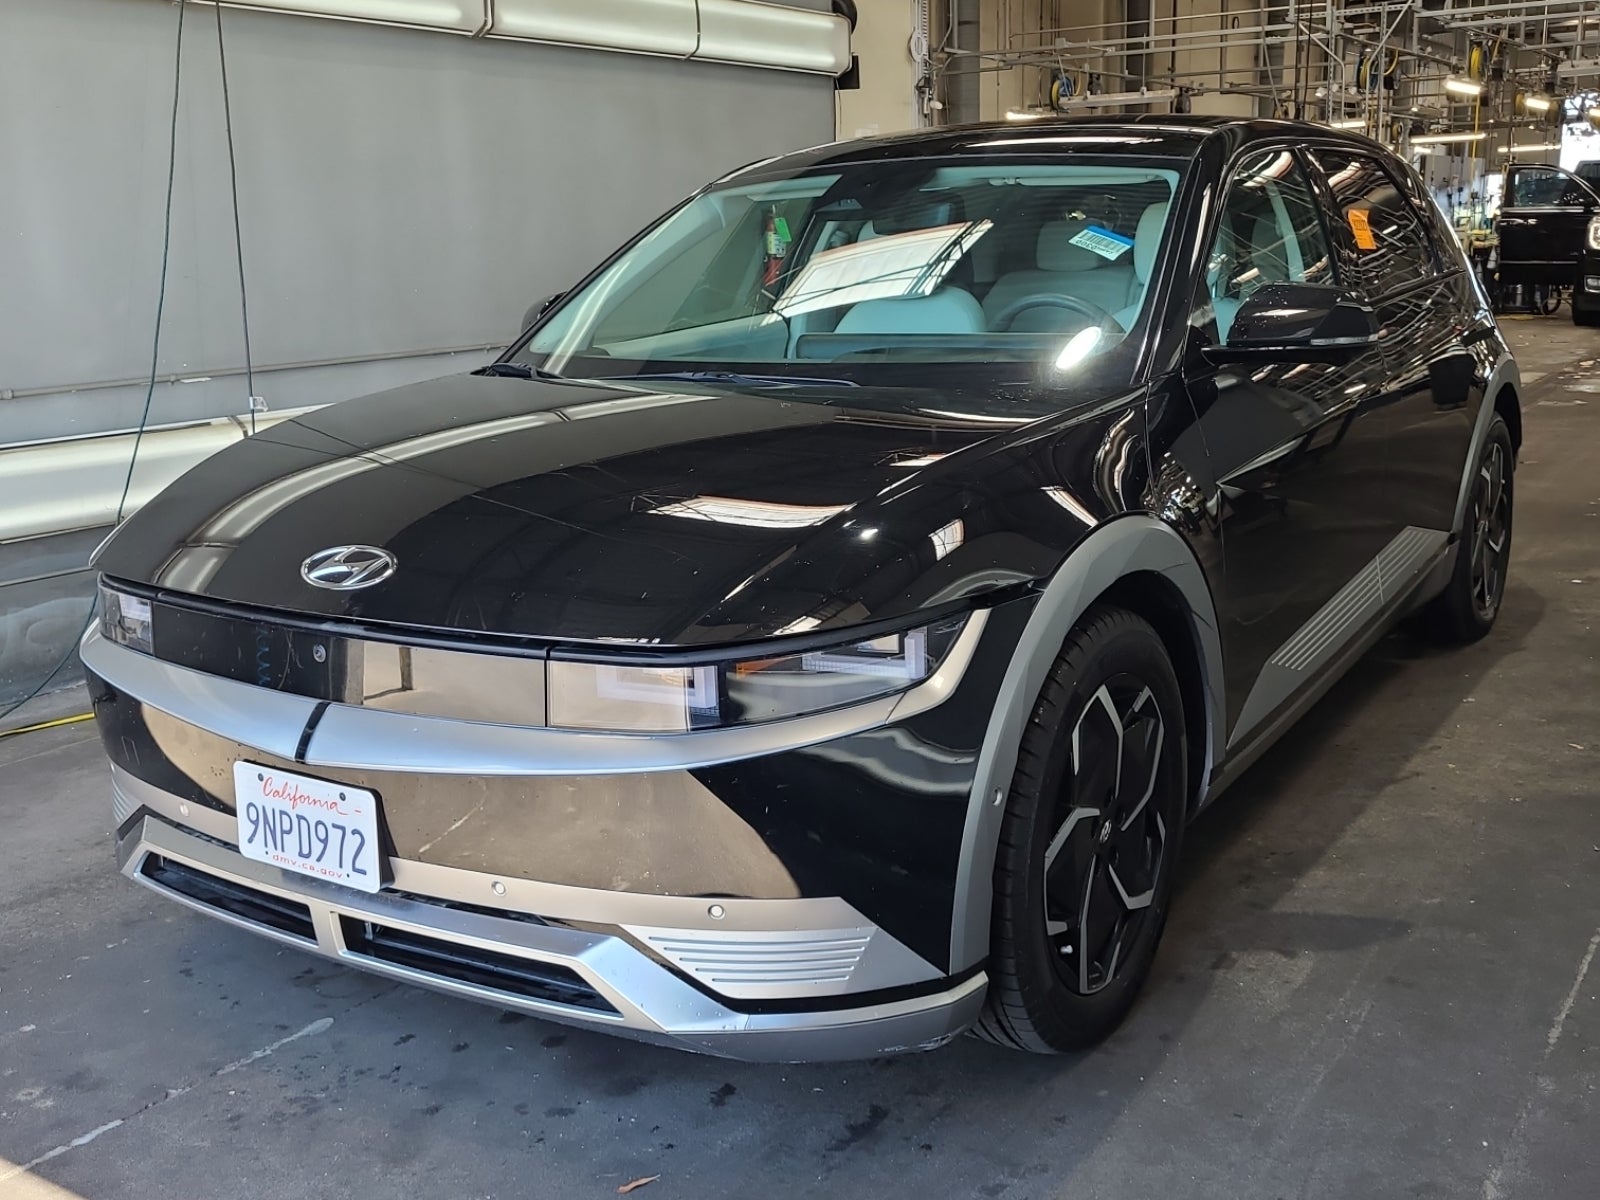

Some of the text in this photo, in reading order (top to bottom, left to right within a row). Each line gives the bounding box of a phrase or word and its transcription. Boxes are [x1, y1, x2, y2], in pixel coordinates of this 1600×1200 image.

[262, 777, 350, 815] California
[246, 802, 367, 876] 9NPD972
[272, 854, 343, 879] dmv.ca.gov
